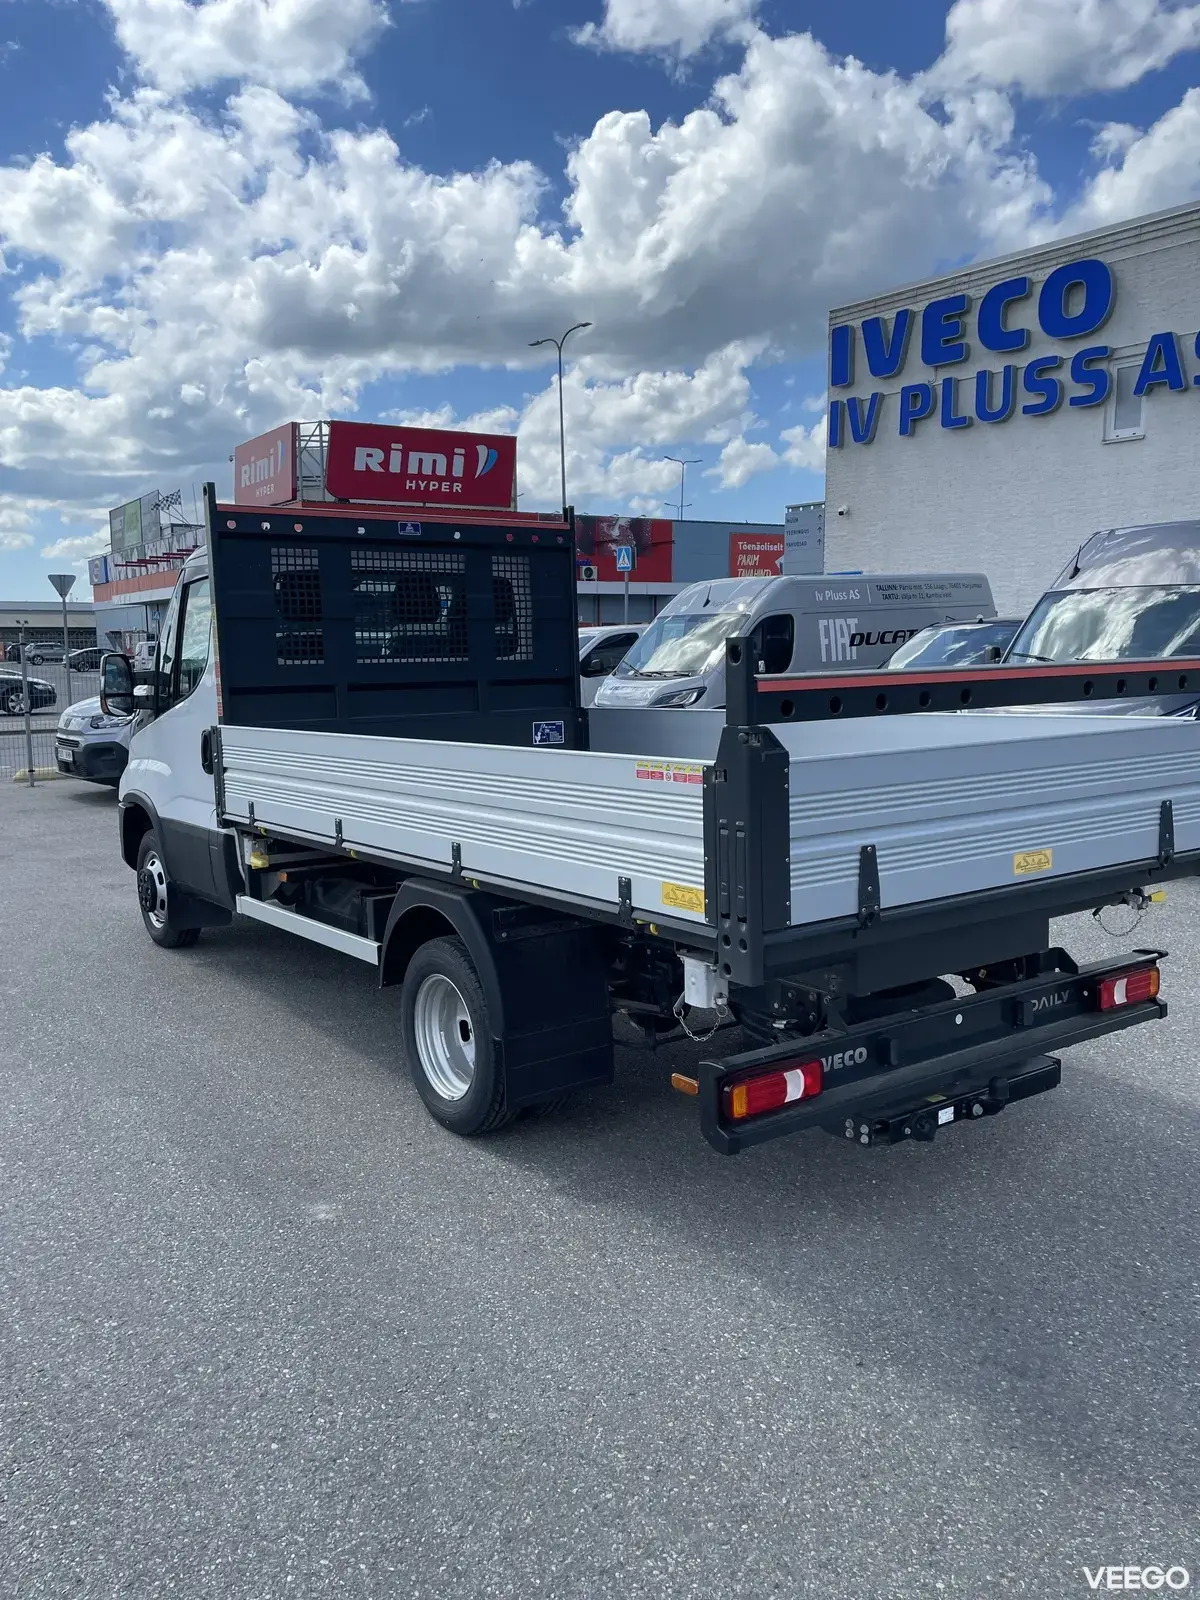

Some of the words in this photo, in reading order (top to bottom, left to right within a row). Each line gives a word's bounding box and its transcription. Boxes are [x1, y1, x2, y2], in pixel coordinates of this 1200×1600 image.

[830, 258, 1117, 388] IVECO
[828, 391, 885, 449] IV
[898, 344, 1115, 437] PLUSS
[1132, 327, 1200, 397] A
[241, 447, 275, 489] Rimi
[353, 443, 466, 478] Rimi
[405, 479, 463, 493] HYPER
[737, 541, 784, 551] Tõenäoliselt
[737, 554, 760, 566] PARIM
[825, 589, 848, 601] Pluss
[849, 588, 861, 600] AS
[875, 584, 900, 592] TALLINN:
[818, 617, 858, 663] FIAT
[849, 628, 919, 647] DUCAT
[820, 1046, 868, 1072] VECO
